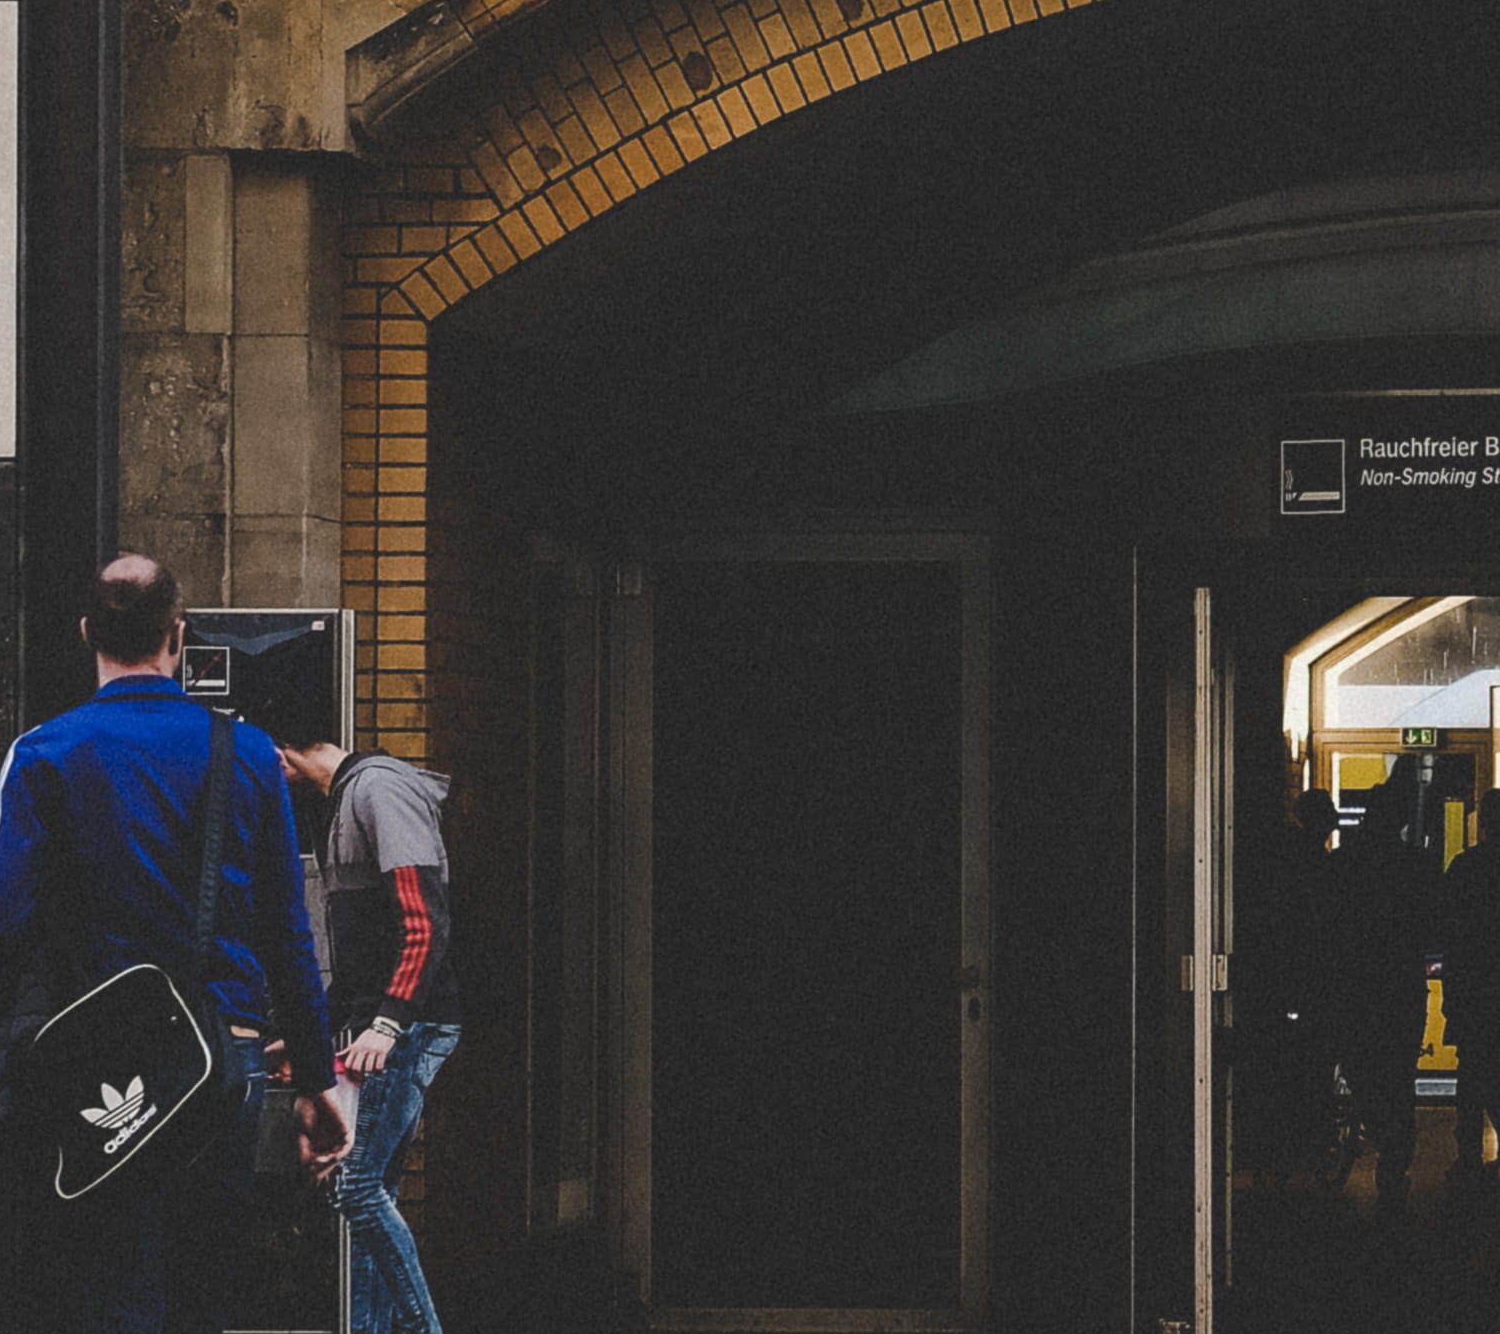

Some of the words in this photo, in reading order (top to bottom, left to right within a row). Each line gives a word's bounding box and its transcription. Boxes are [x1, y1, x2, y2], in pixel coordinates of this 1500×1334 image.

[1360, 437, 1479, 458] Rauchfreier
[1360, 468, 1477, 488] Non-Smoking
[103, 1102, 158, 1154] adidas
